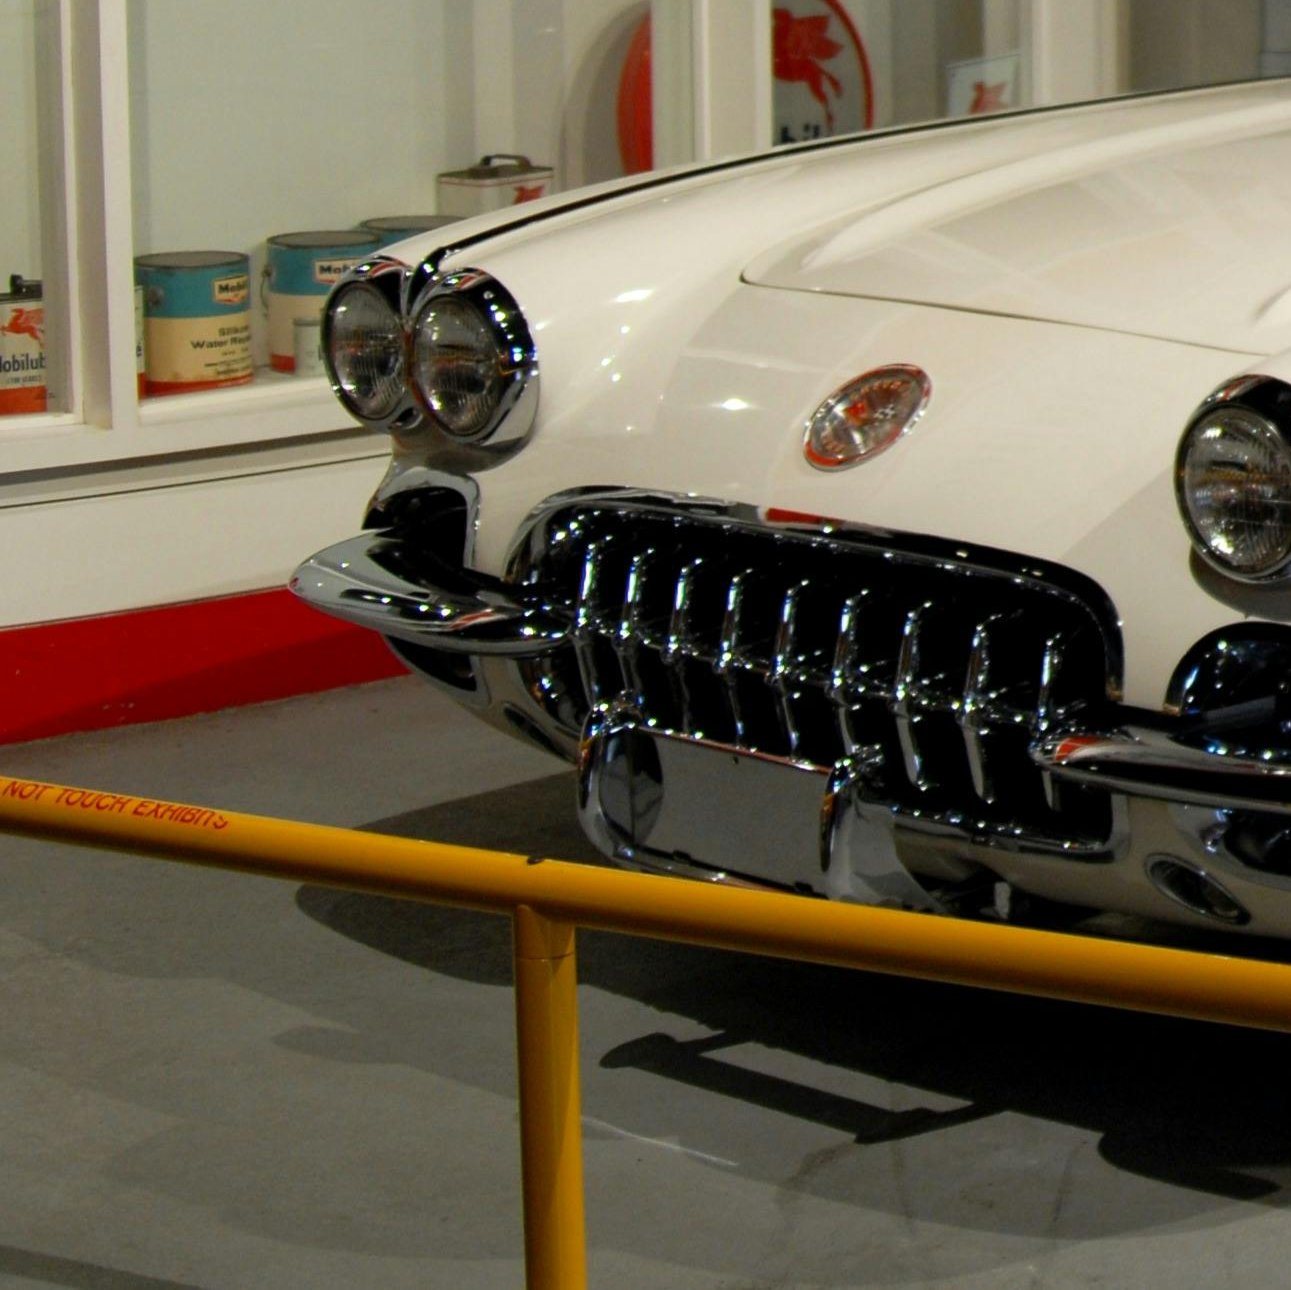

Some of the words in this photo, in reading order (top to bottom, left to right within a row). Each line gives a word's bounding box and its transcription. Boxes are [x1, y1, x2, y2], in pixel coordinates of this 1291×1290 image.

[3, 780, 54, 800] NOT
[56, 788, 134, 813] TOUCH
[133, 800, 229, 829] EXHIBITS
